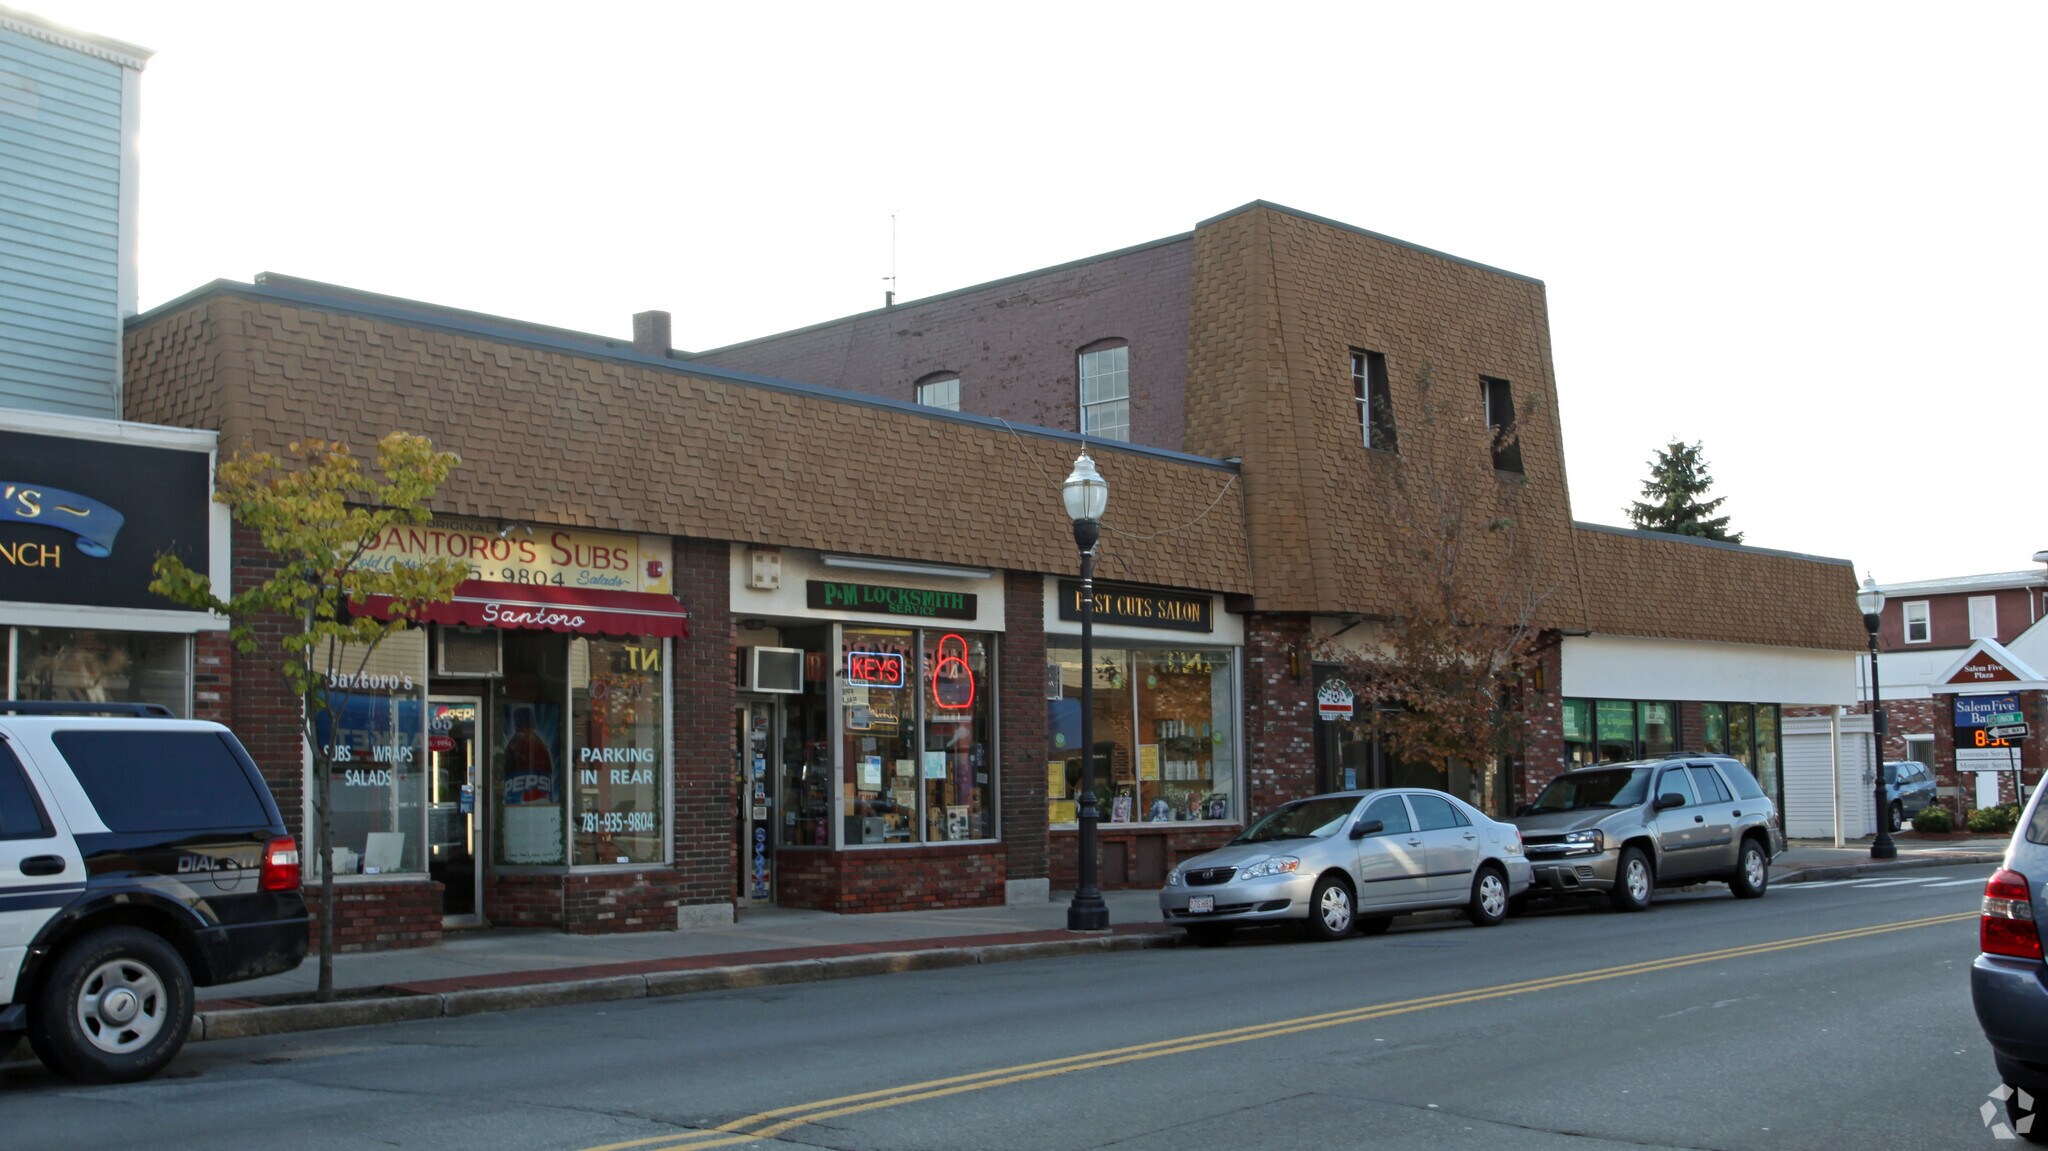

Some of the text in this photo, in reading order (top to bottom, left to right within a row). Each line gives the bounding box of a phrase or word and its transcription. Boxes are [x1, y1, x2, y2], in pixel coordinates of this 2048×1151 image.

[425, 520, 494, 533] ORIGINAL
[550, 531, 630, 571] SUBS
[385, 555, 416, 571] Cts
[576, 571, 624, 588] Salads
[863, 585, 964, 610] LOCKSMITH
[482, 603, 585, 628] Santoro
[888, 601, 935, 616] SERVICE
[1116, 595, 1152, 617] CUTS
[1157, 599, 1200, 622] SALON
[851, 658, 899, 682] KEYS
[1964, 663, 2003, 673] Salem Five
[1974, 671, 1994, 679] Plaza
[372, 746, 413, 763] WRAPS
[580, 747, 654, 763] PARKING
[345, 769, 392, 787] SALADS
[580, 769, 654, 785] IN REAR
[581, 812, 654, 833] 781-935-9804
[177, 855, 221, 873] DIAL
